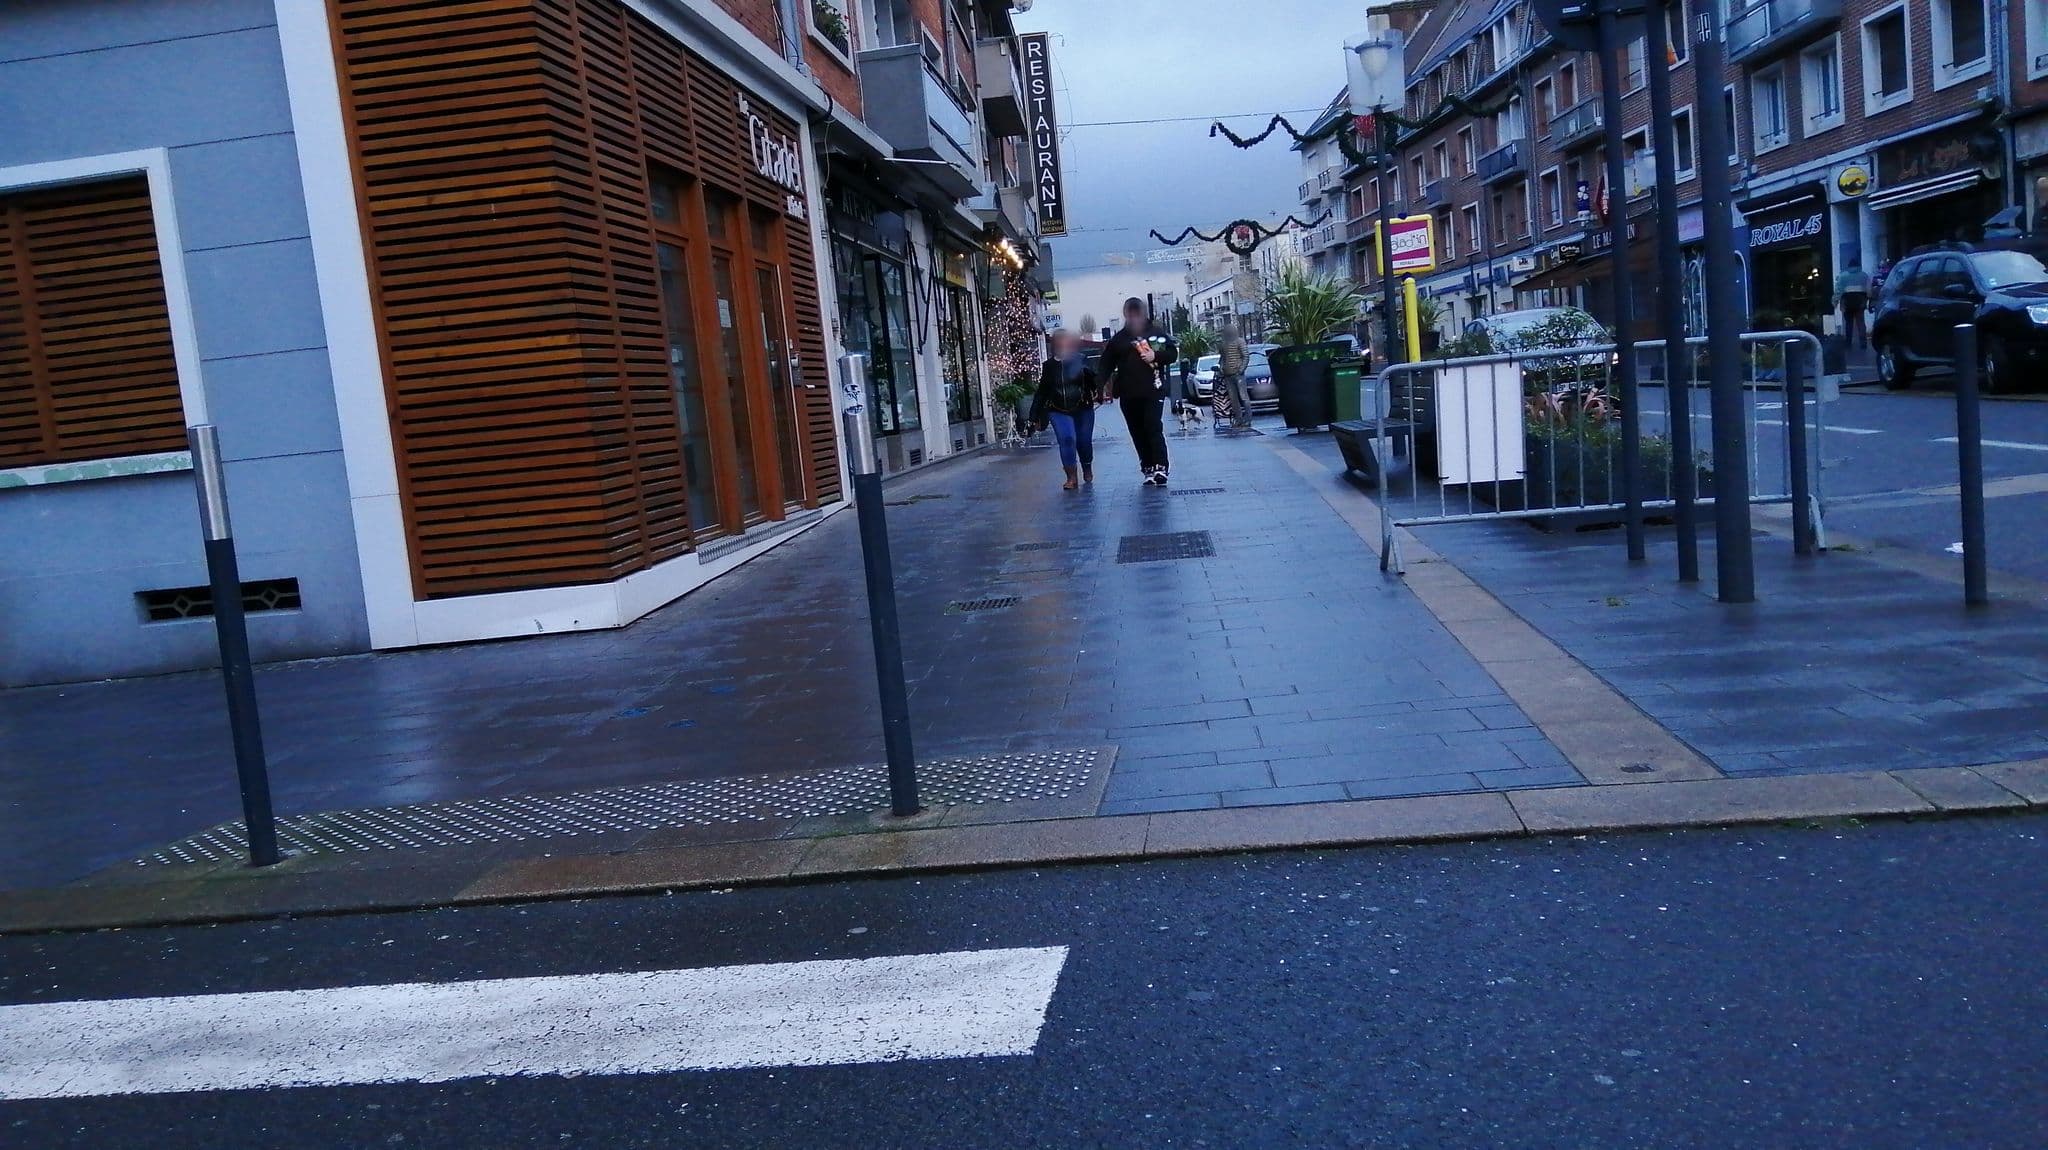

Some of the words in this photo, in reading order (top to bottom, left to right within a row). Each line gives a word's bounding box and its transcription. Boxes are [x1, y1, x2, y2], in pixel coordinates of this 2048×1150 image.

[749, 114, 804, 194] Citadel
[1027, 42, 1057, 218] RESTAURANT
[1749, 219, 1803, 247] ROYAL
[1804, 213, 1823, 235] 45
[1045, 314, 1061, 323] gan
